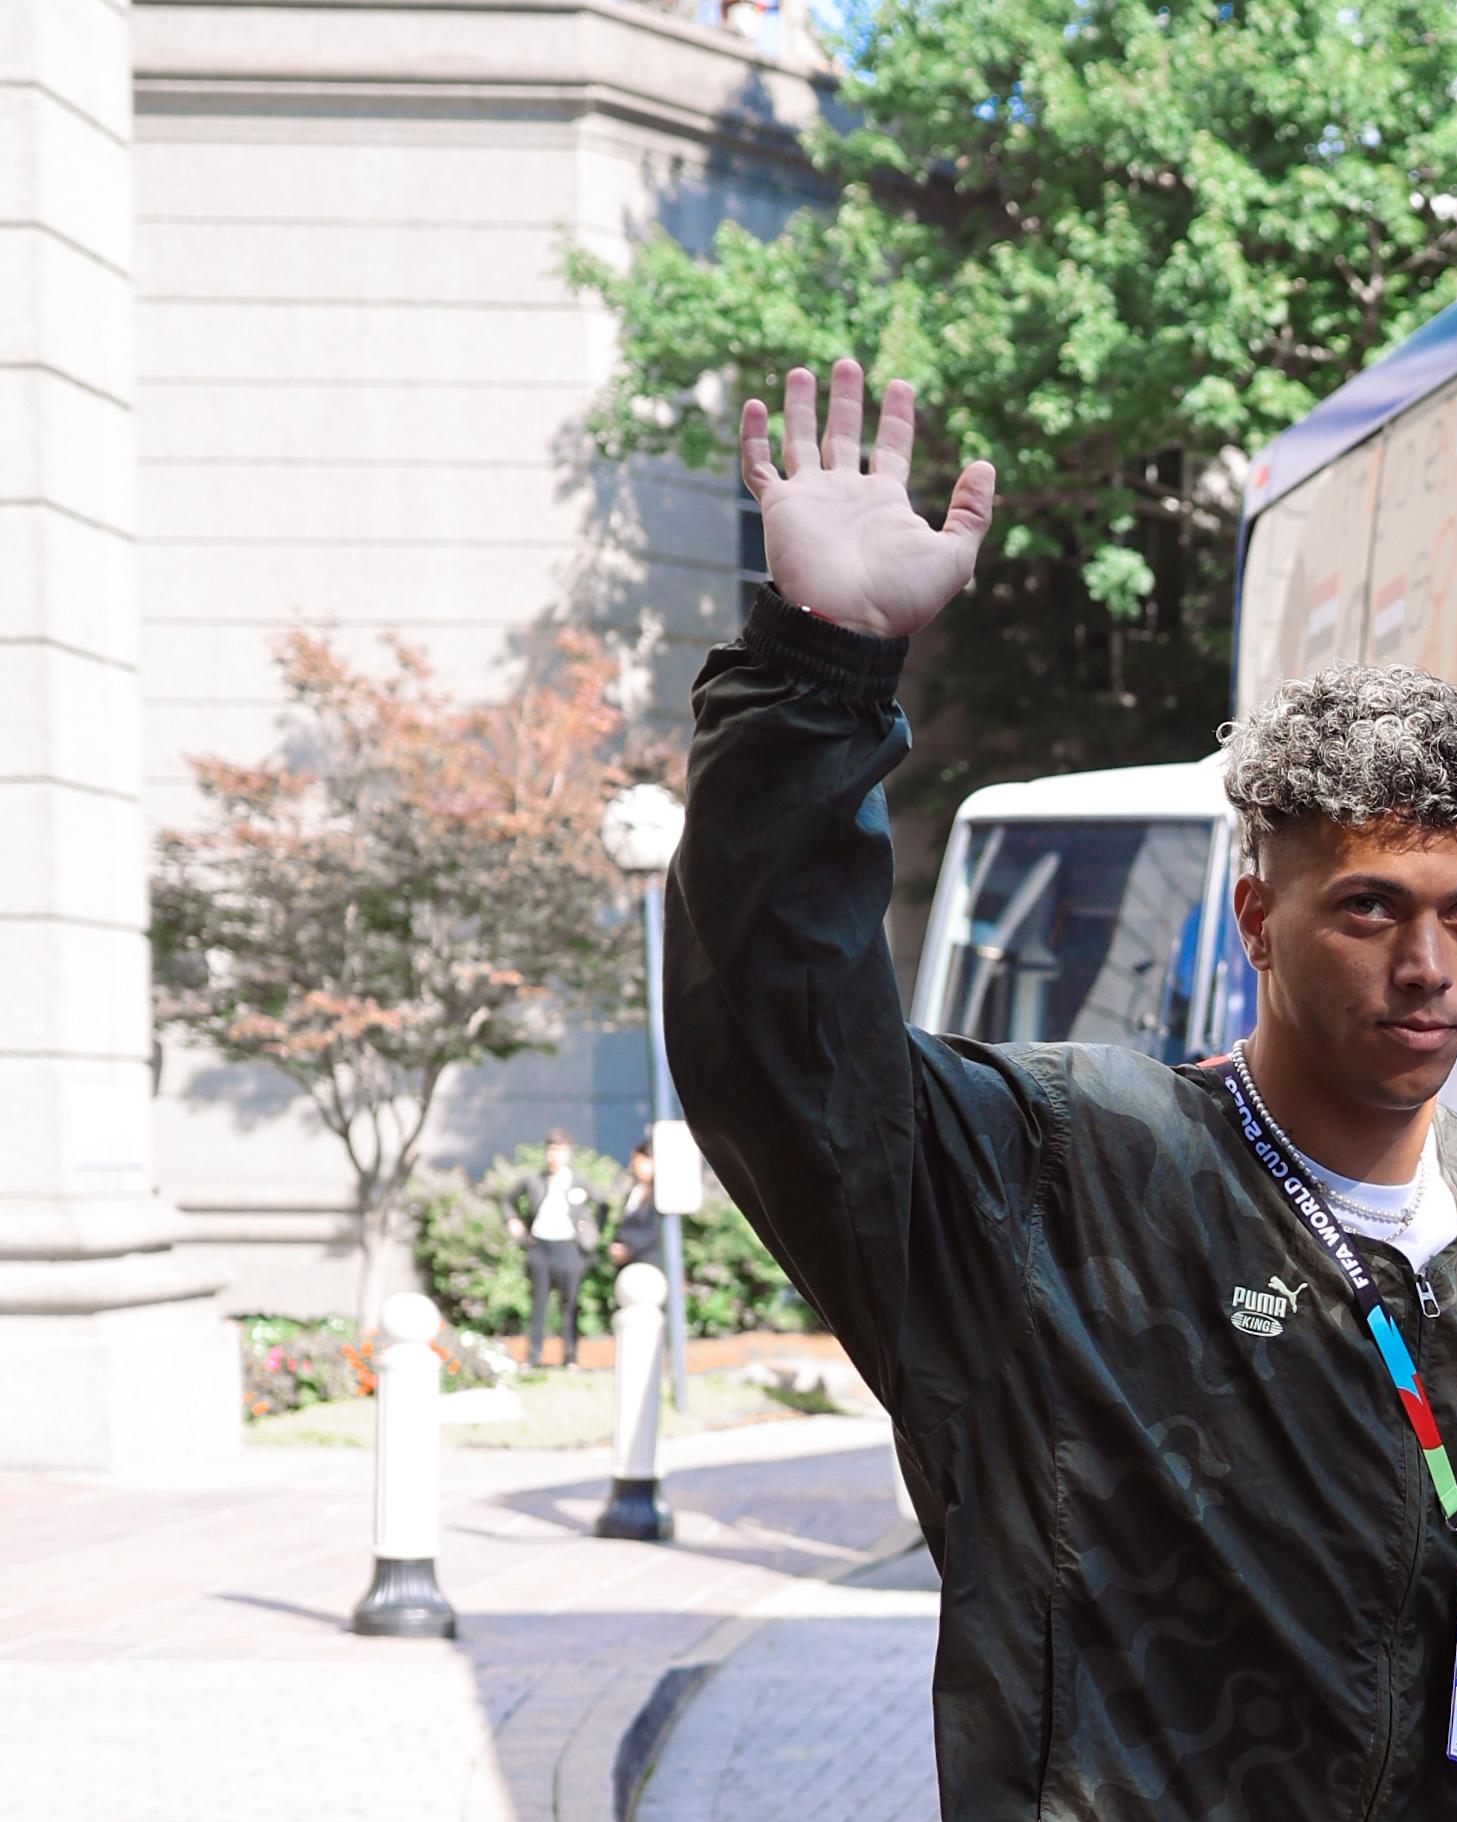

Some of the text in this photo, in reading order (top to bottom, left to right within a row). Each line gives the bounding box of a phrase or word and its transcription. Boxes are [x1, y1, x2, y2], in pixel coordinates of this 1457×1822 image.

[1255, 1141, 1289, 1180] CUP
[1284, 1177, 1340, 1248] WORLD
[1336, 1243, 1370, 1290] FIFA
[1232, 1286, 1287, 1318] PUMA
[1242, 1315, 1271, 1332] KING
